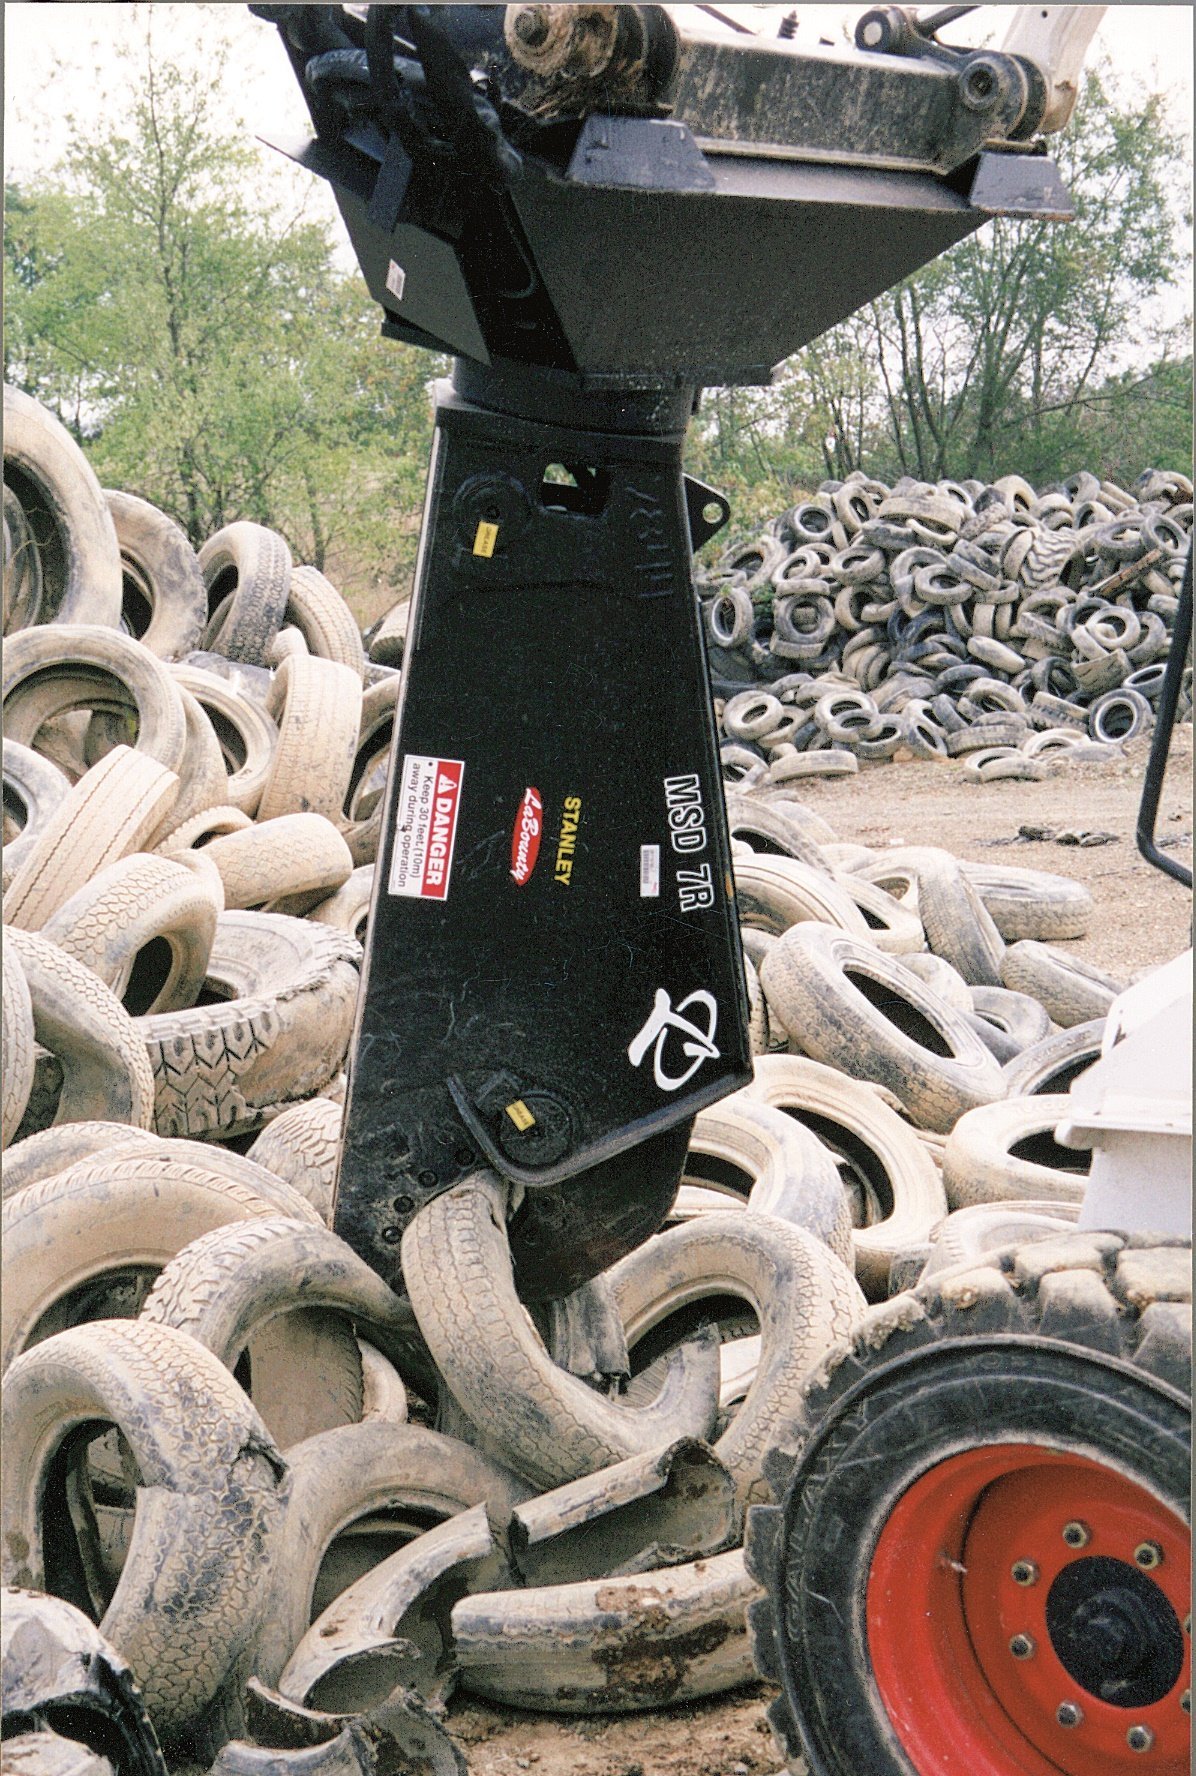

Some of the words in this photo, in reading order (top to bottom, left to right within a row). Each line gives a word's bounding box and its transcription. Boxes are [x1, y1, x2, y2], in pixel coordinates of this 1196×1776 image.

[408, 762, 421, 793] away
[419, 775, 434, 805] Keep
[401, 795, 418, 832] during
[418, 807, 429, 821] 30
[510, 787, 542, 881] LaBounty
[664, 773, 707, 853] MSD
[398, 834, 412, 888] operation
[425, 797, 453, 887] DANGER
[554, 796, 582, 886] STANLEY
[676, 863, 715, 913] 7R
